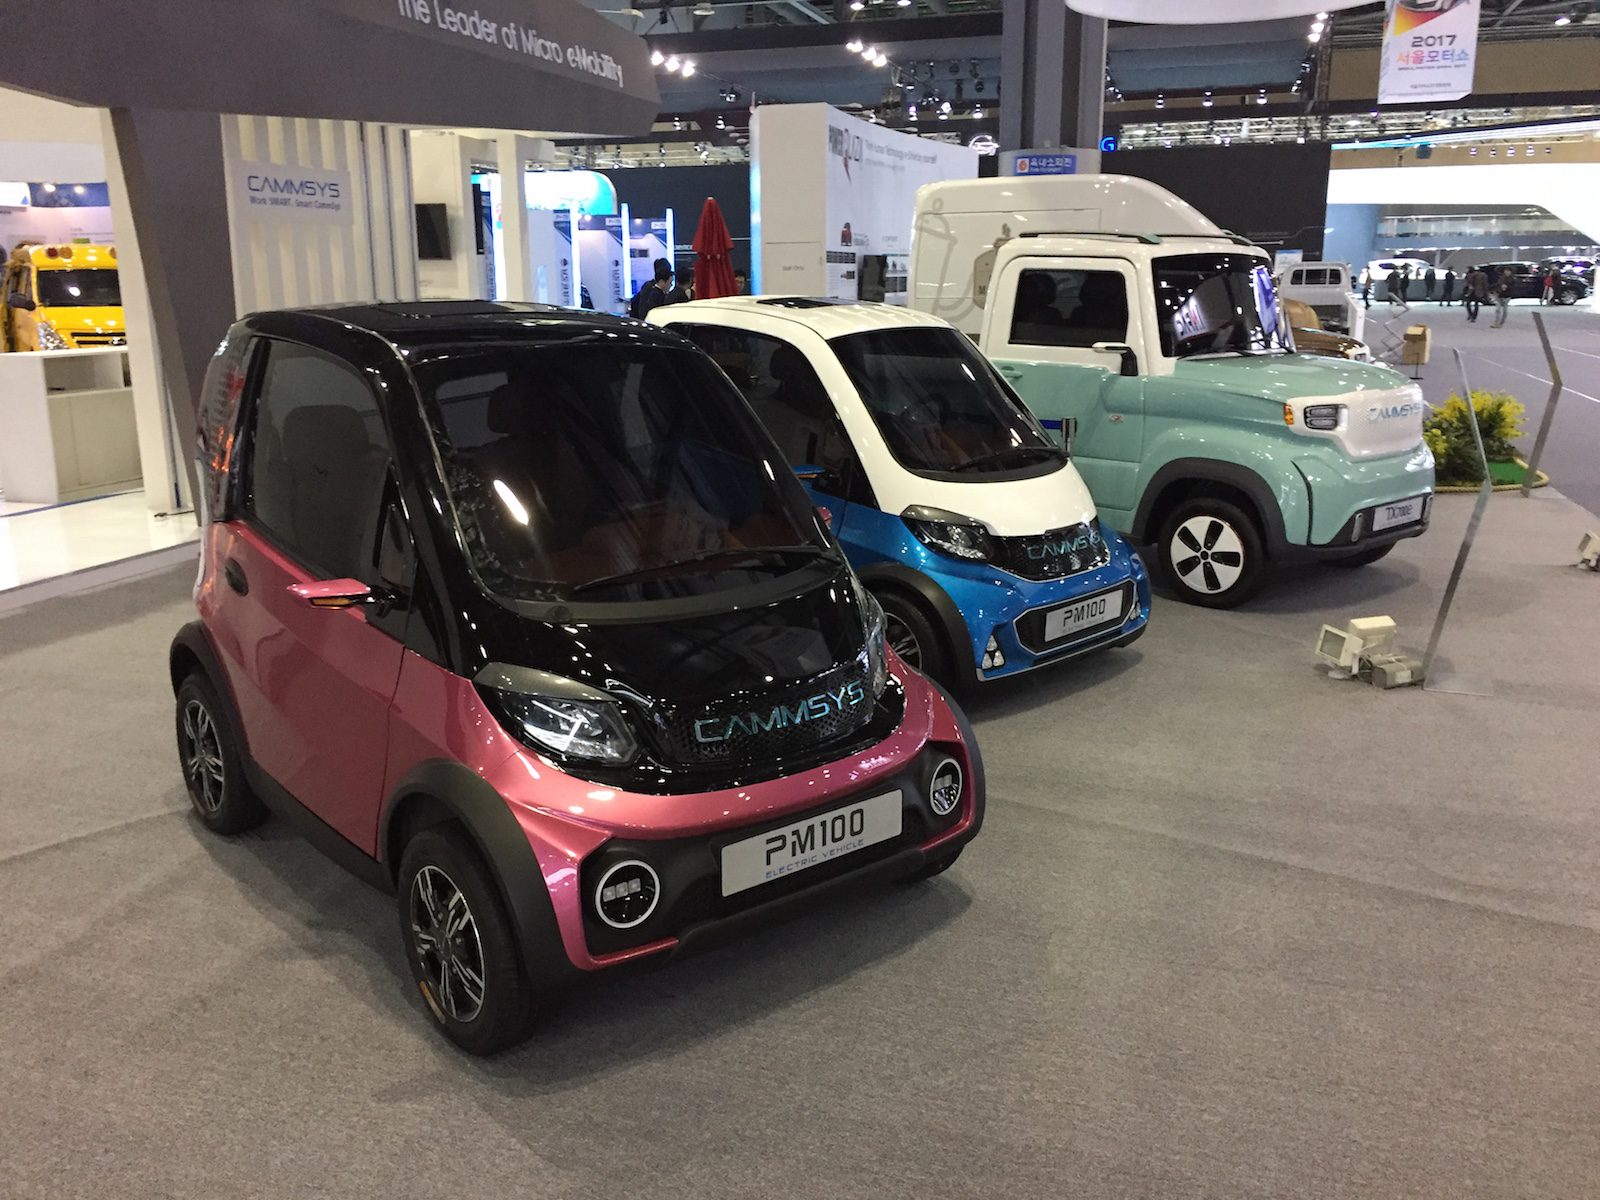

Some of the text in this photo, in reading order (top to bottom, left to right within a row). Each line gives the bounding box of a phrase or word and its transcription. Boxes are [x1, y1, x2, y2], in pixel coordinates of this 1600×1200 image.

[434, 0, 498, 45] Leader
[501, 22, 518, 51] of
[519, 26, 563, 65] Micro
[1411, 34, 1457, 48] 2017
[1396, 48, 1470, 65] 서울모터쇼
[247, 175, 340, 198] CAMMSYS
[1027, 532, 1100, 560] CAMMSYS
[1062, 598, 1106, 627] PM100
[694, 680, 865, 743] CAMMSYS
[765, 808, 864, 867] PM100
[765, 838, 865, 880] ELECTRIC VEHICLE
